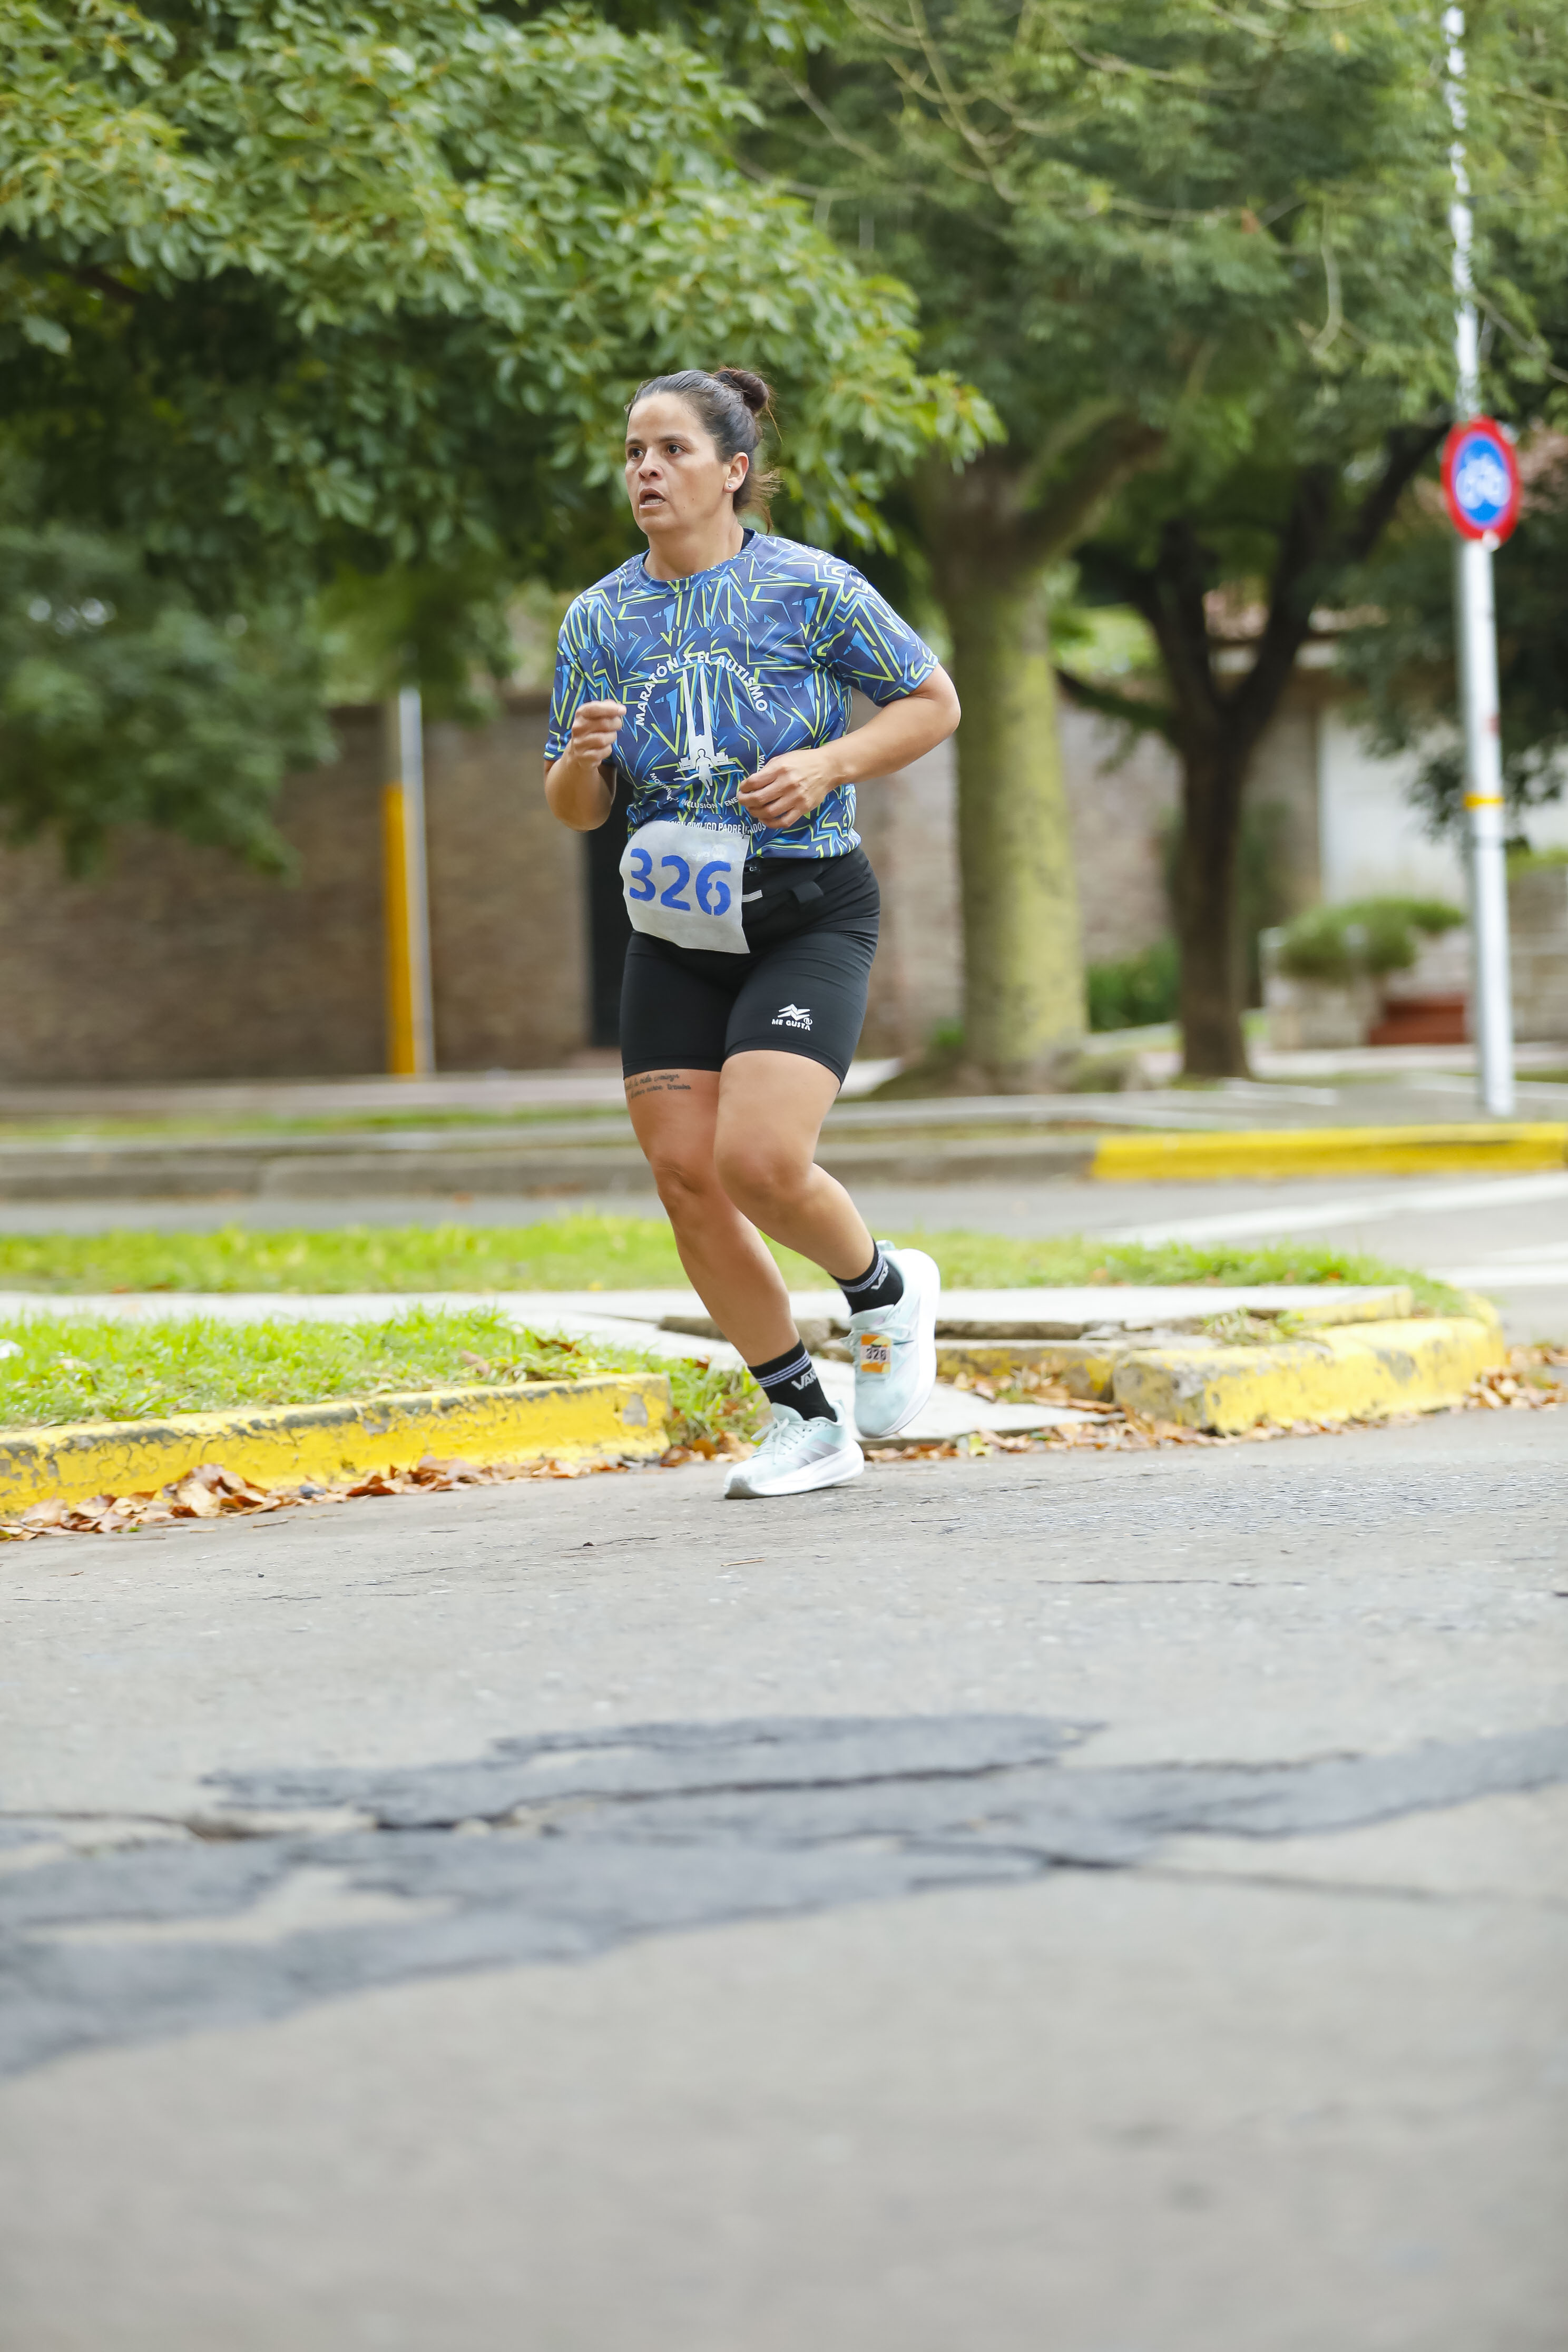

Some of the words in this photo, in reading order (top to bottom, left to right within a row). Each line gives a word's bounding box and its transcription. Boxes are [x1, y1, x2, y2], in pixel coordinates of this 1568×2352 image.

[635, 658, 680, 726] MARATÓN
[683, 653, 693, 665] X
[697, 651, 711, 664] EL
[714, 655, 768, 711] AUTISMO
[681, 798, 718, 809] INCLUSIÓN
[629, 847, 731, 916] 326
[786, 1020, 811, 1031] GUSTA
[791, 1366, 817, 1390] VAN
